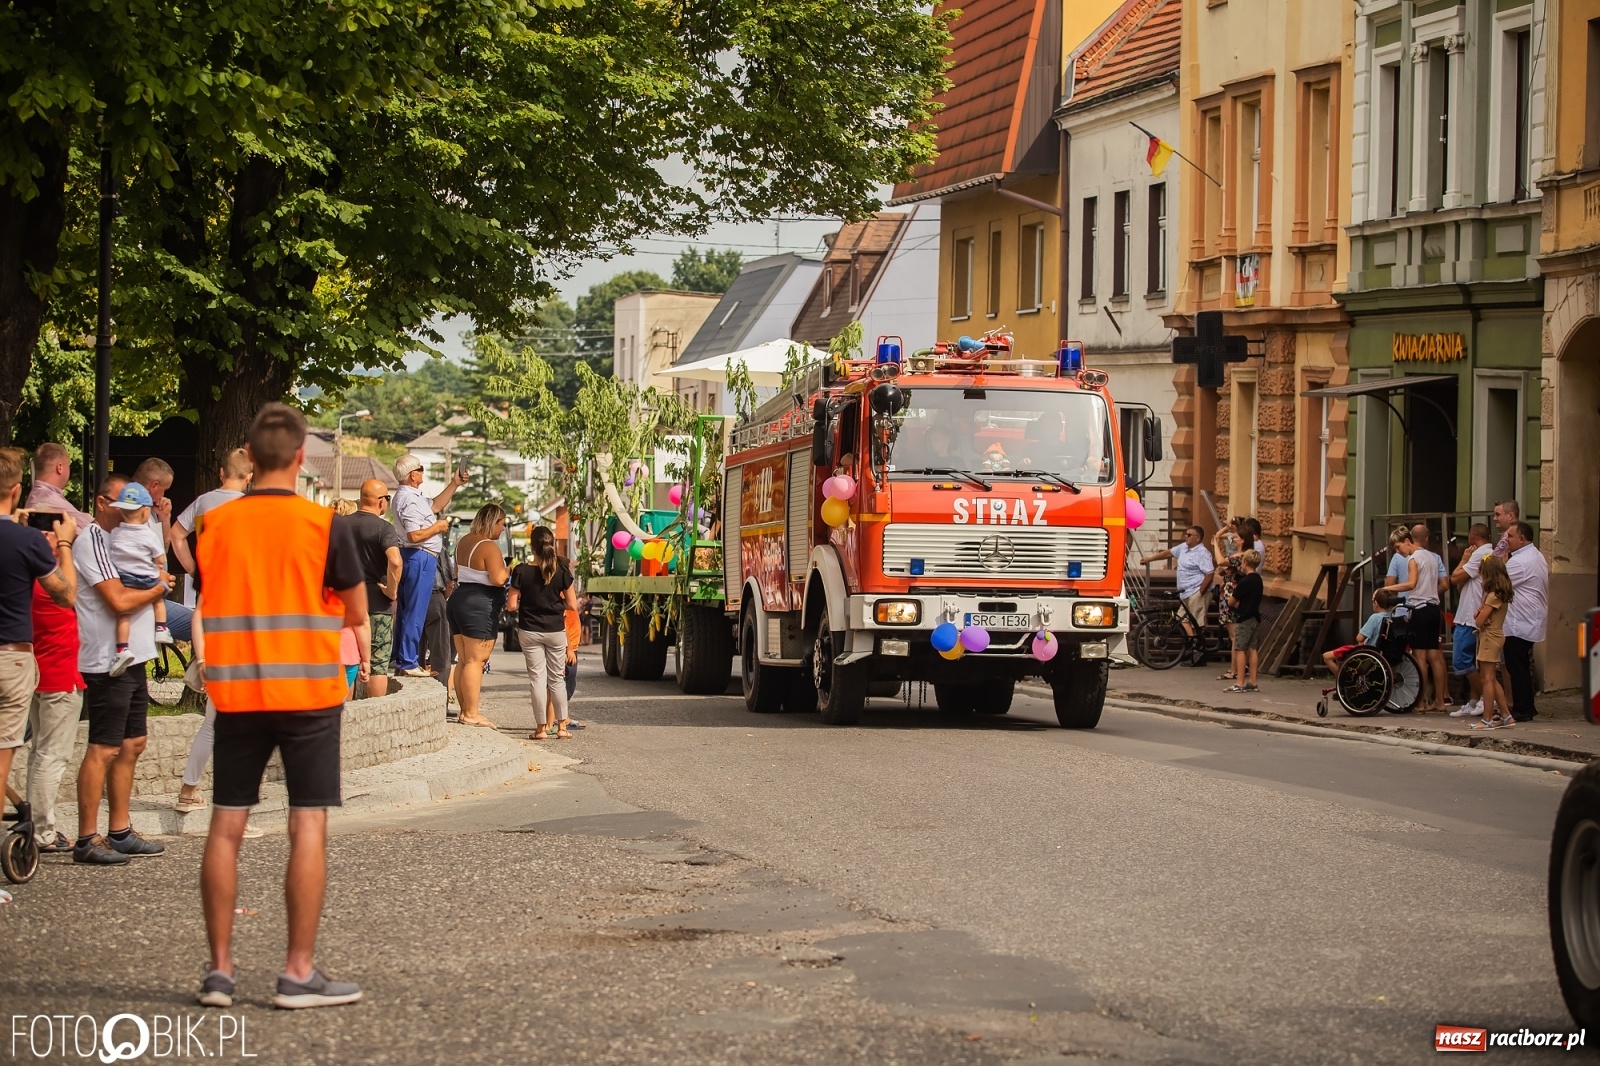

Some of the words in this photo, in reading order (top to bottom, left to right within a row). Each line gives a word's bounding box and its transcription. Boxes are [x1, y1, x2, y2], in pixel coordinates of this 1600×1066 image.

[1392, 332, 1463, 363] KWIACIARNIA
[953, 493, 1047, 526] STRAŻ
[972, 614, 997, 626] SRC
[1001, 615, 1027, 627] 1E36
